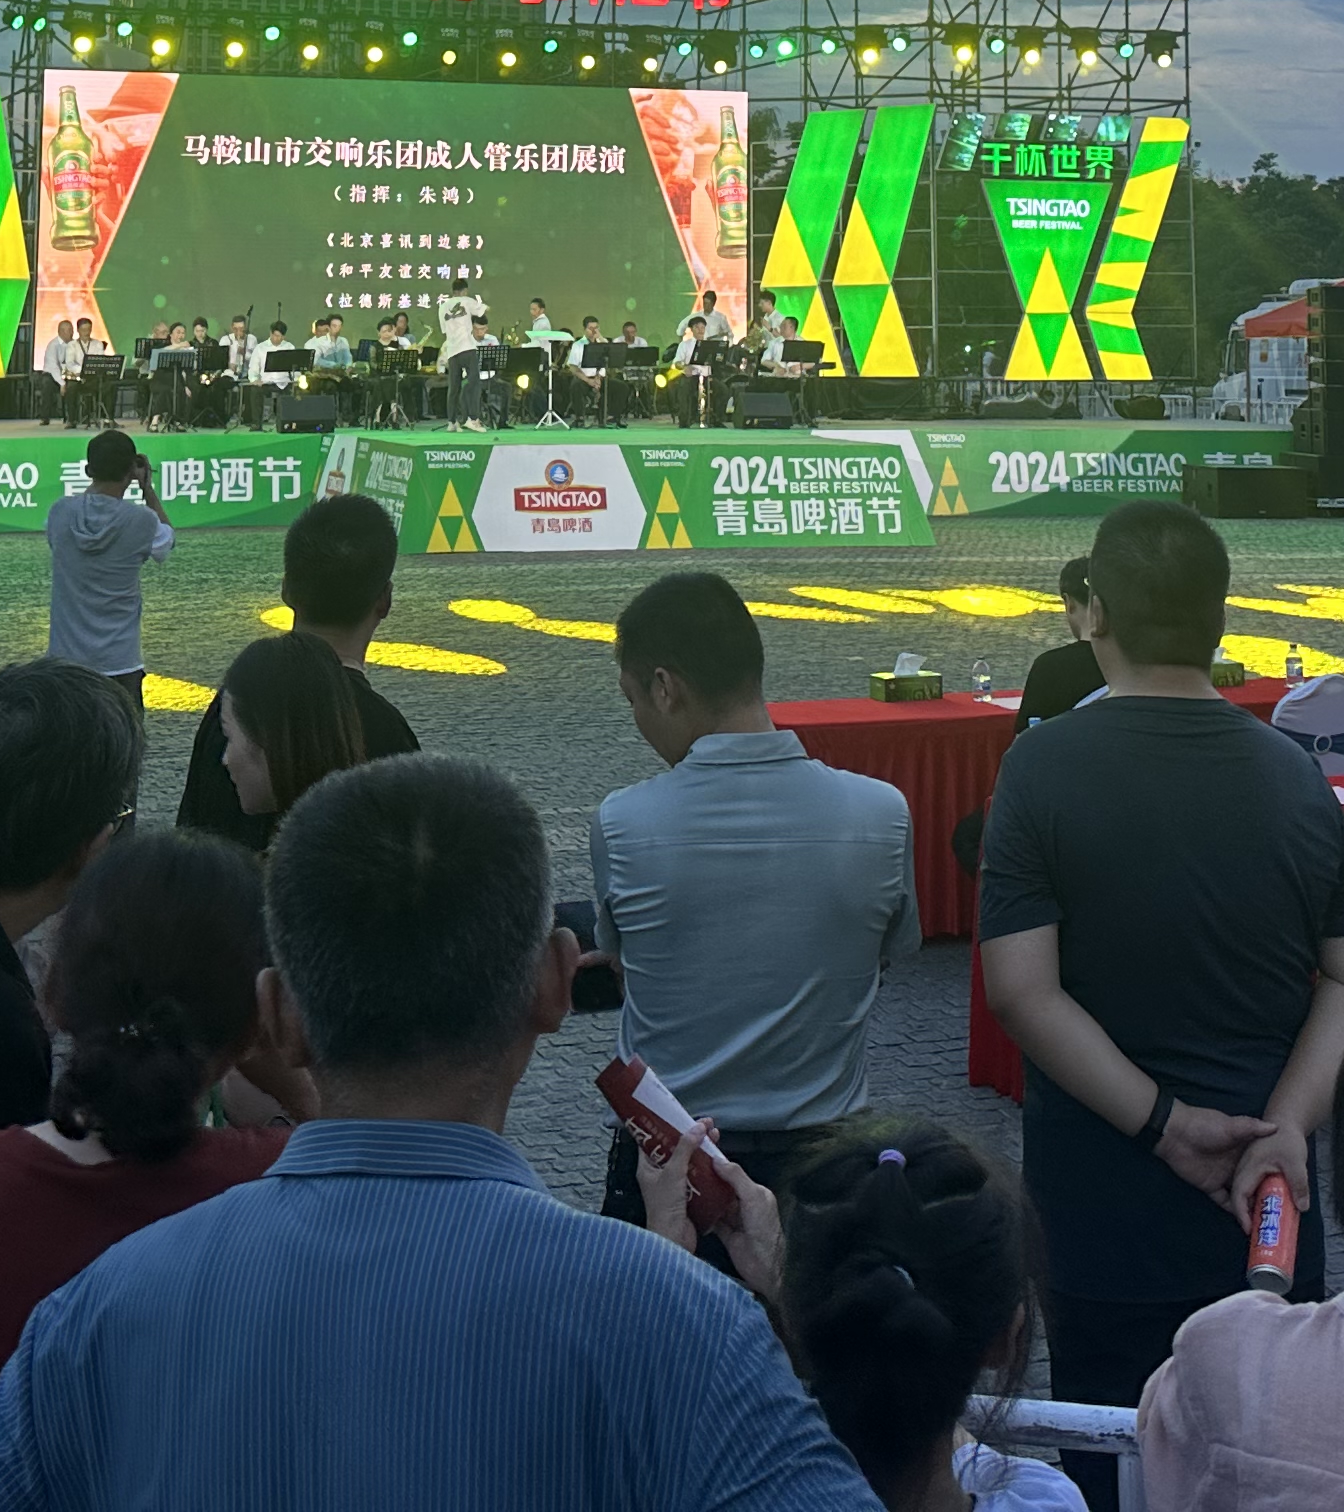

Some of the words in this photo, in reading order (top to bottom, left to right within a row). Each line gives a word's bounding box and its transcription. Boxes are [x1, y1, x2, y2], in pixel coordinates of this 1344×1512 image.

[180, 134, 627, 175] 马鞍山市交响乐团成人管乐团展演
[980, 142, 1114, 180] 干杯世界
[1005, 197, 1091, 218] TSINGTAO
[1011, 219, 1038, 229] BEER
[1039, 219, 1084, 230] FESTIVAL
[325, 292, 483, 309] 《拉德斯基进行》
[424, 450, 476, 462] TSINGTAO
[640, 449, 689, 460] TSINGTAO
[710, 455, 788, 495] 2024
[788, 457, 901, 480] TSINGTAO
[988, 450, 1071, 493] 2024
[1070, 452, 1186, 476] TSINGTAO
[789, 481, 830, 494] BEER
[833, 481, 903, 494] FESTIVAL
[1072, 479, 1114, 493] BEER
[519, 491, 602, 508] TSINGTAO
[1257, 1194, 1282, 1246] 北冰洋
